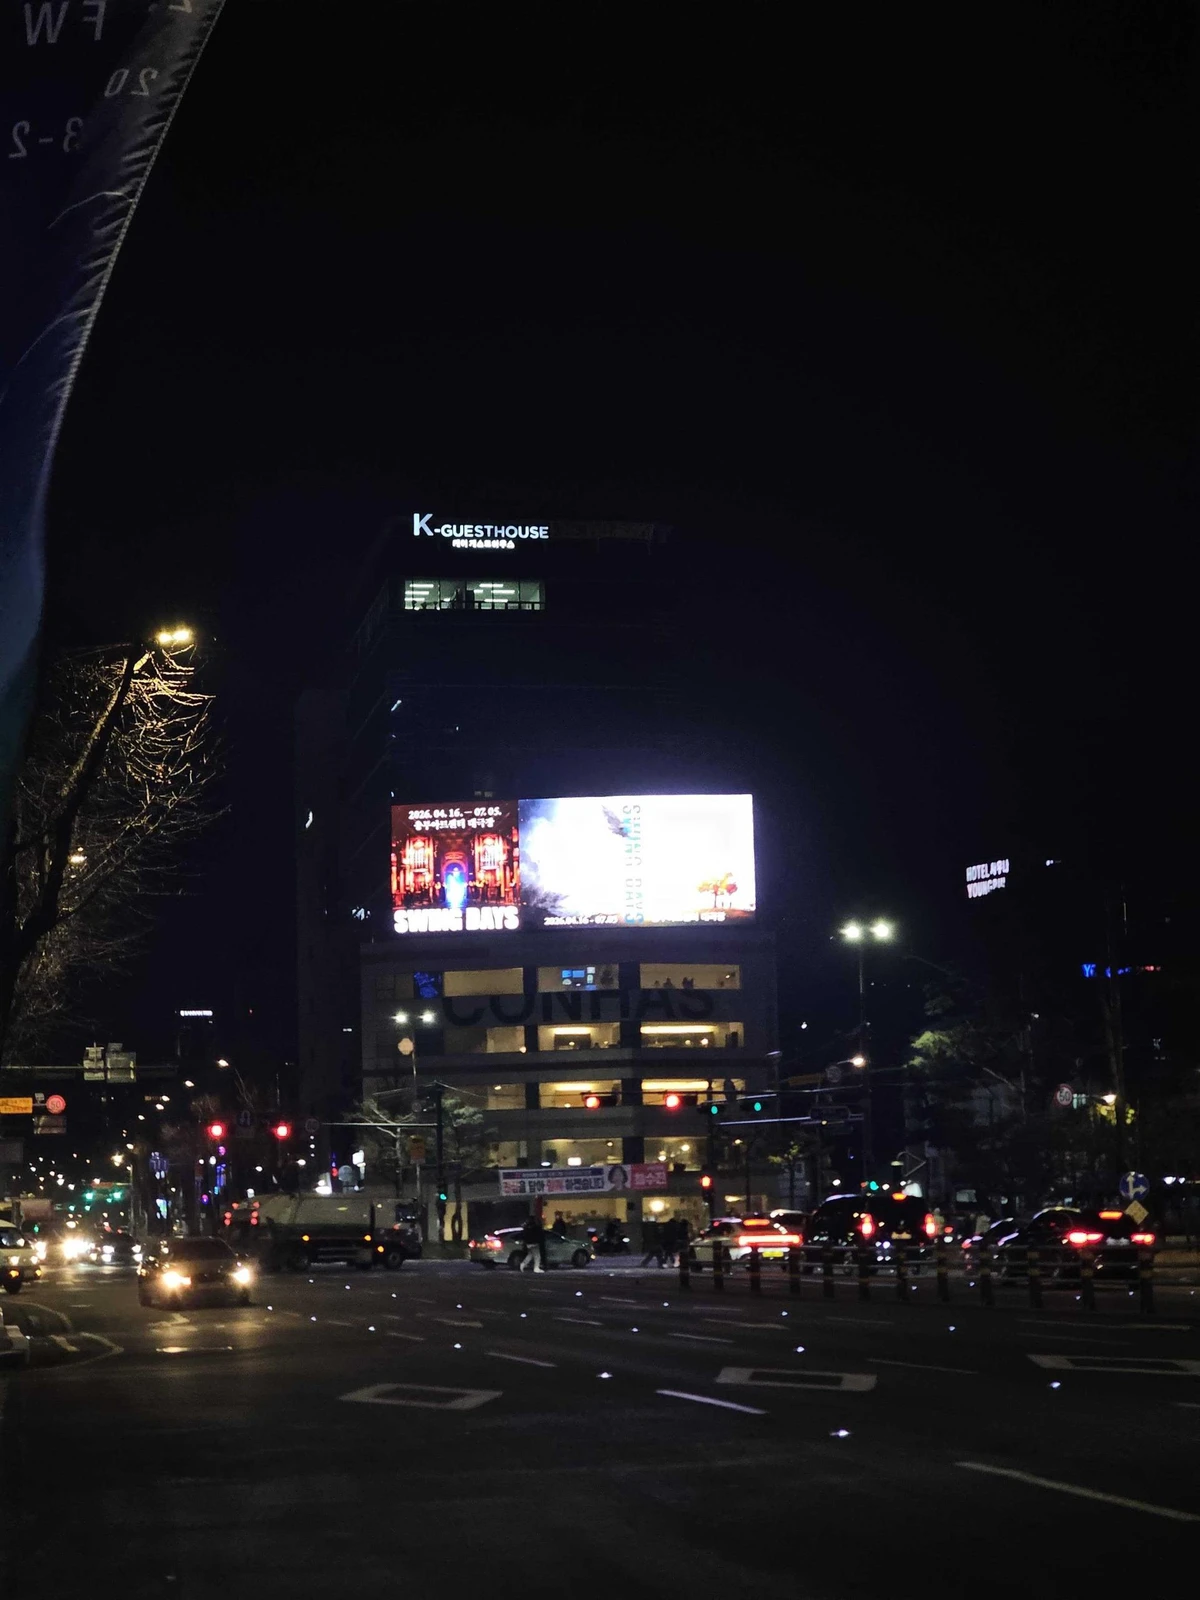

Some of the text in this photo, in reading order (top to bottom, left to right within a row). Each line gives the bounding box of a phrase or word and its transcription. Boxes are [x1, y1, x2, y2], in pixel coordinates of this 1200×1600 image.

[413, 513, 549, 539] K-GUESTHOUSE
[408, 810, 432, 820] 2026.
[449, 808, 463, 817] 16.
[966, 863, 990, 882] HOTEL
[394, 905, 519, 933] SWING DAYS
[1059, 1088, 1071, 1102] 50
